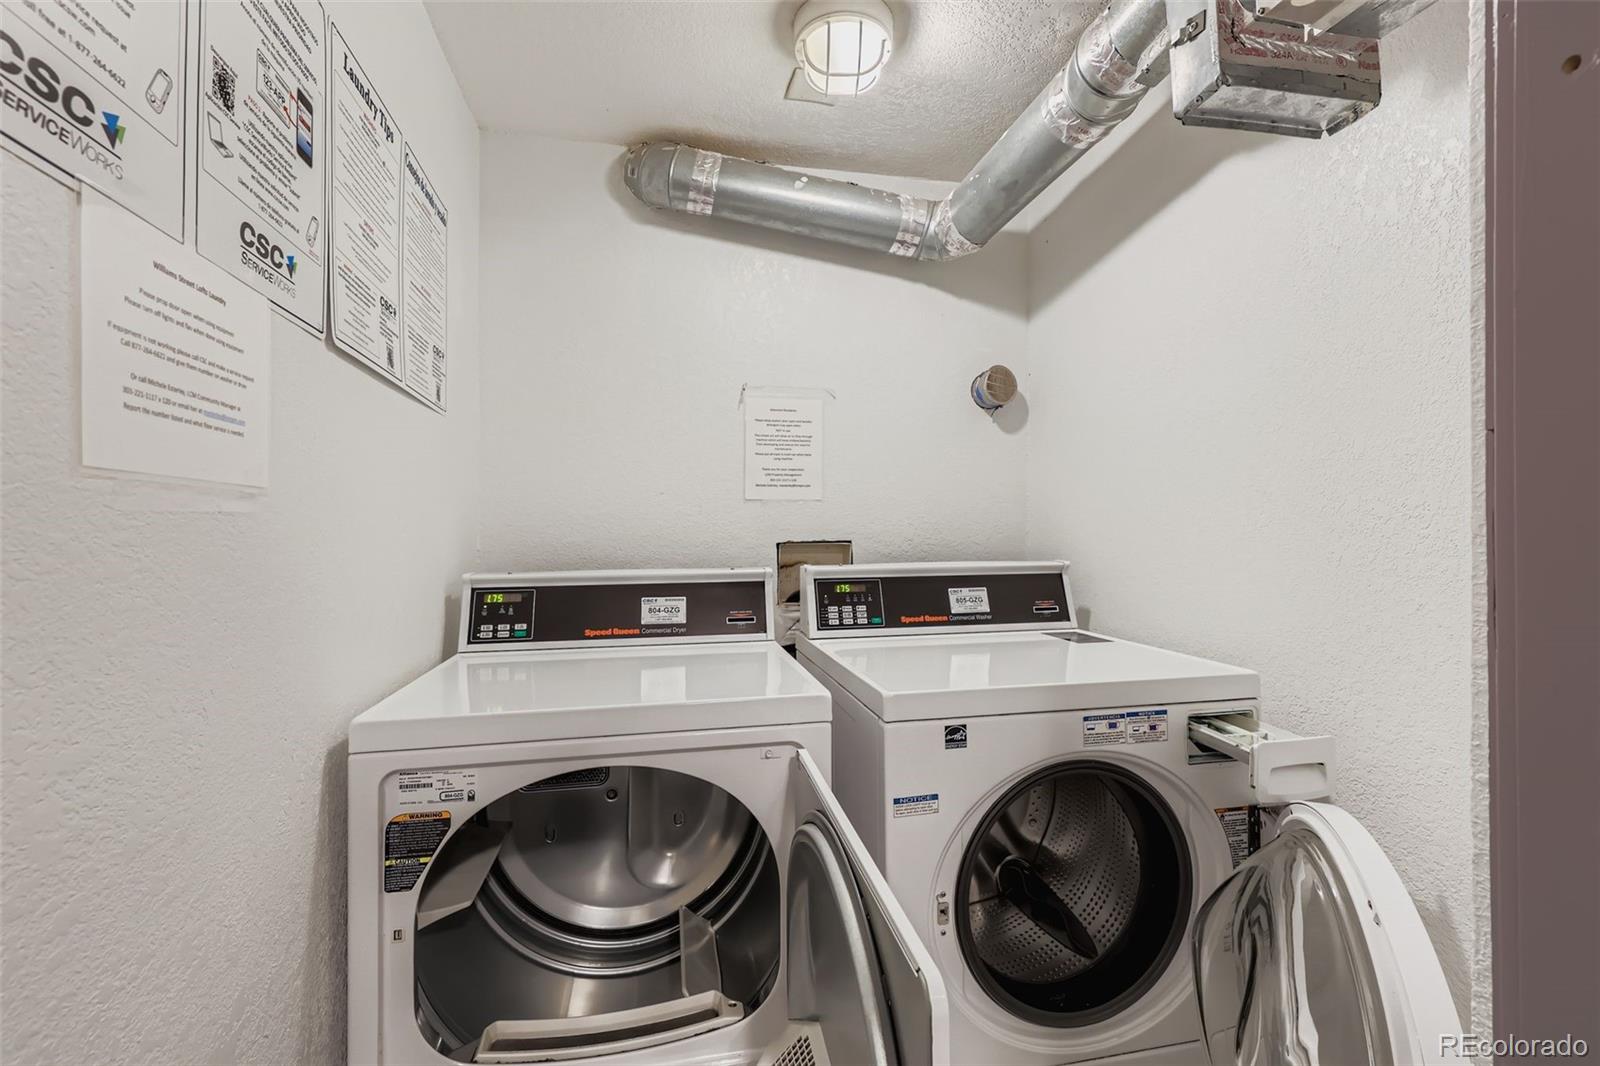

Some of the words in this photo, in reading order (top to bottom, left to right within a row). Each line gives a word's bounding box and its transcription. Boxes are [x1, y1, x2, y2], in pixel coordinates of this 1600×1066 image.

[344, 52, 378, 120] Laundry
[380, 109, 394, 144] Tips
[240, 222, 284, 270] CSC
[178, 273, 194, 288] Street
[900, 616, 924, 624] Speed
[924, 614, 948, 622] Queen
[584, 628, 612, 638] Speed
[613, 628, 640, 636] Queen
[672, 626, 687, 634] Dryer
[900, 796, 930, 804] NOTICE
[408, 811, 443, 820] WARNING
